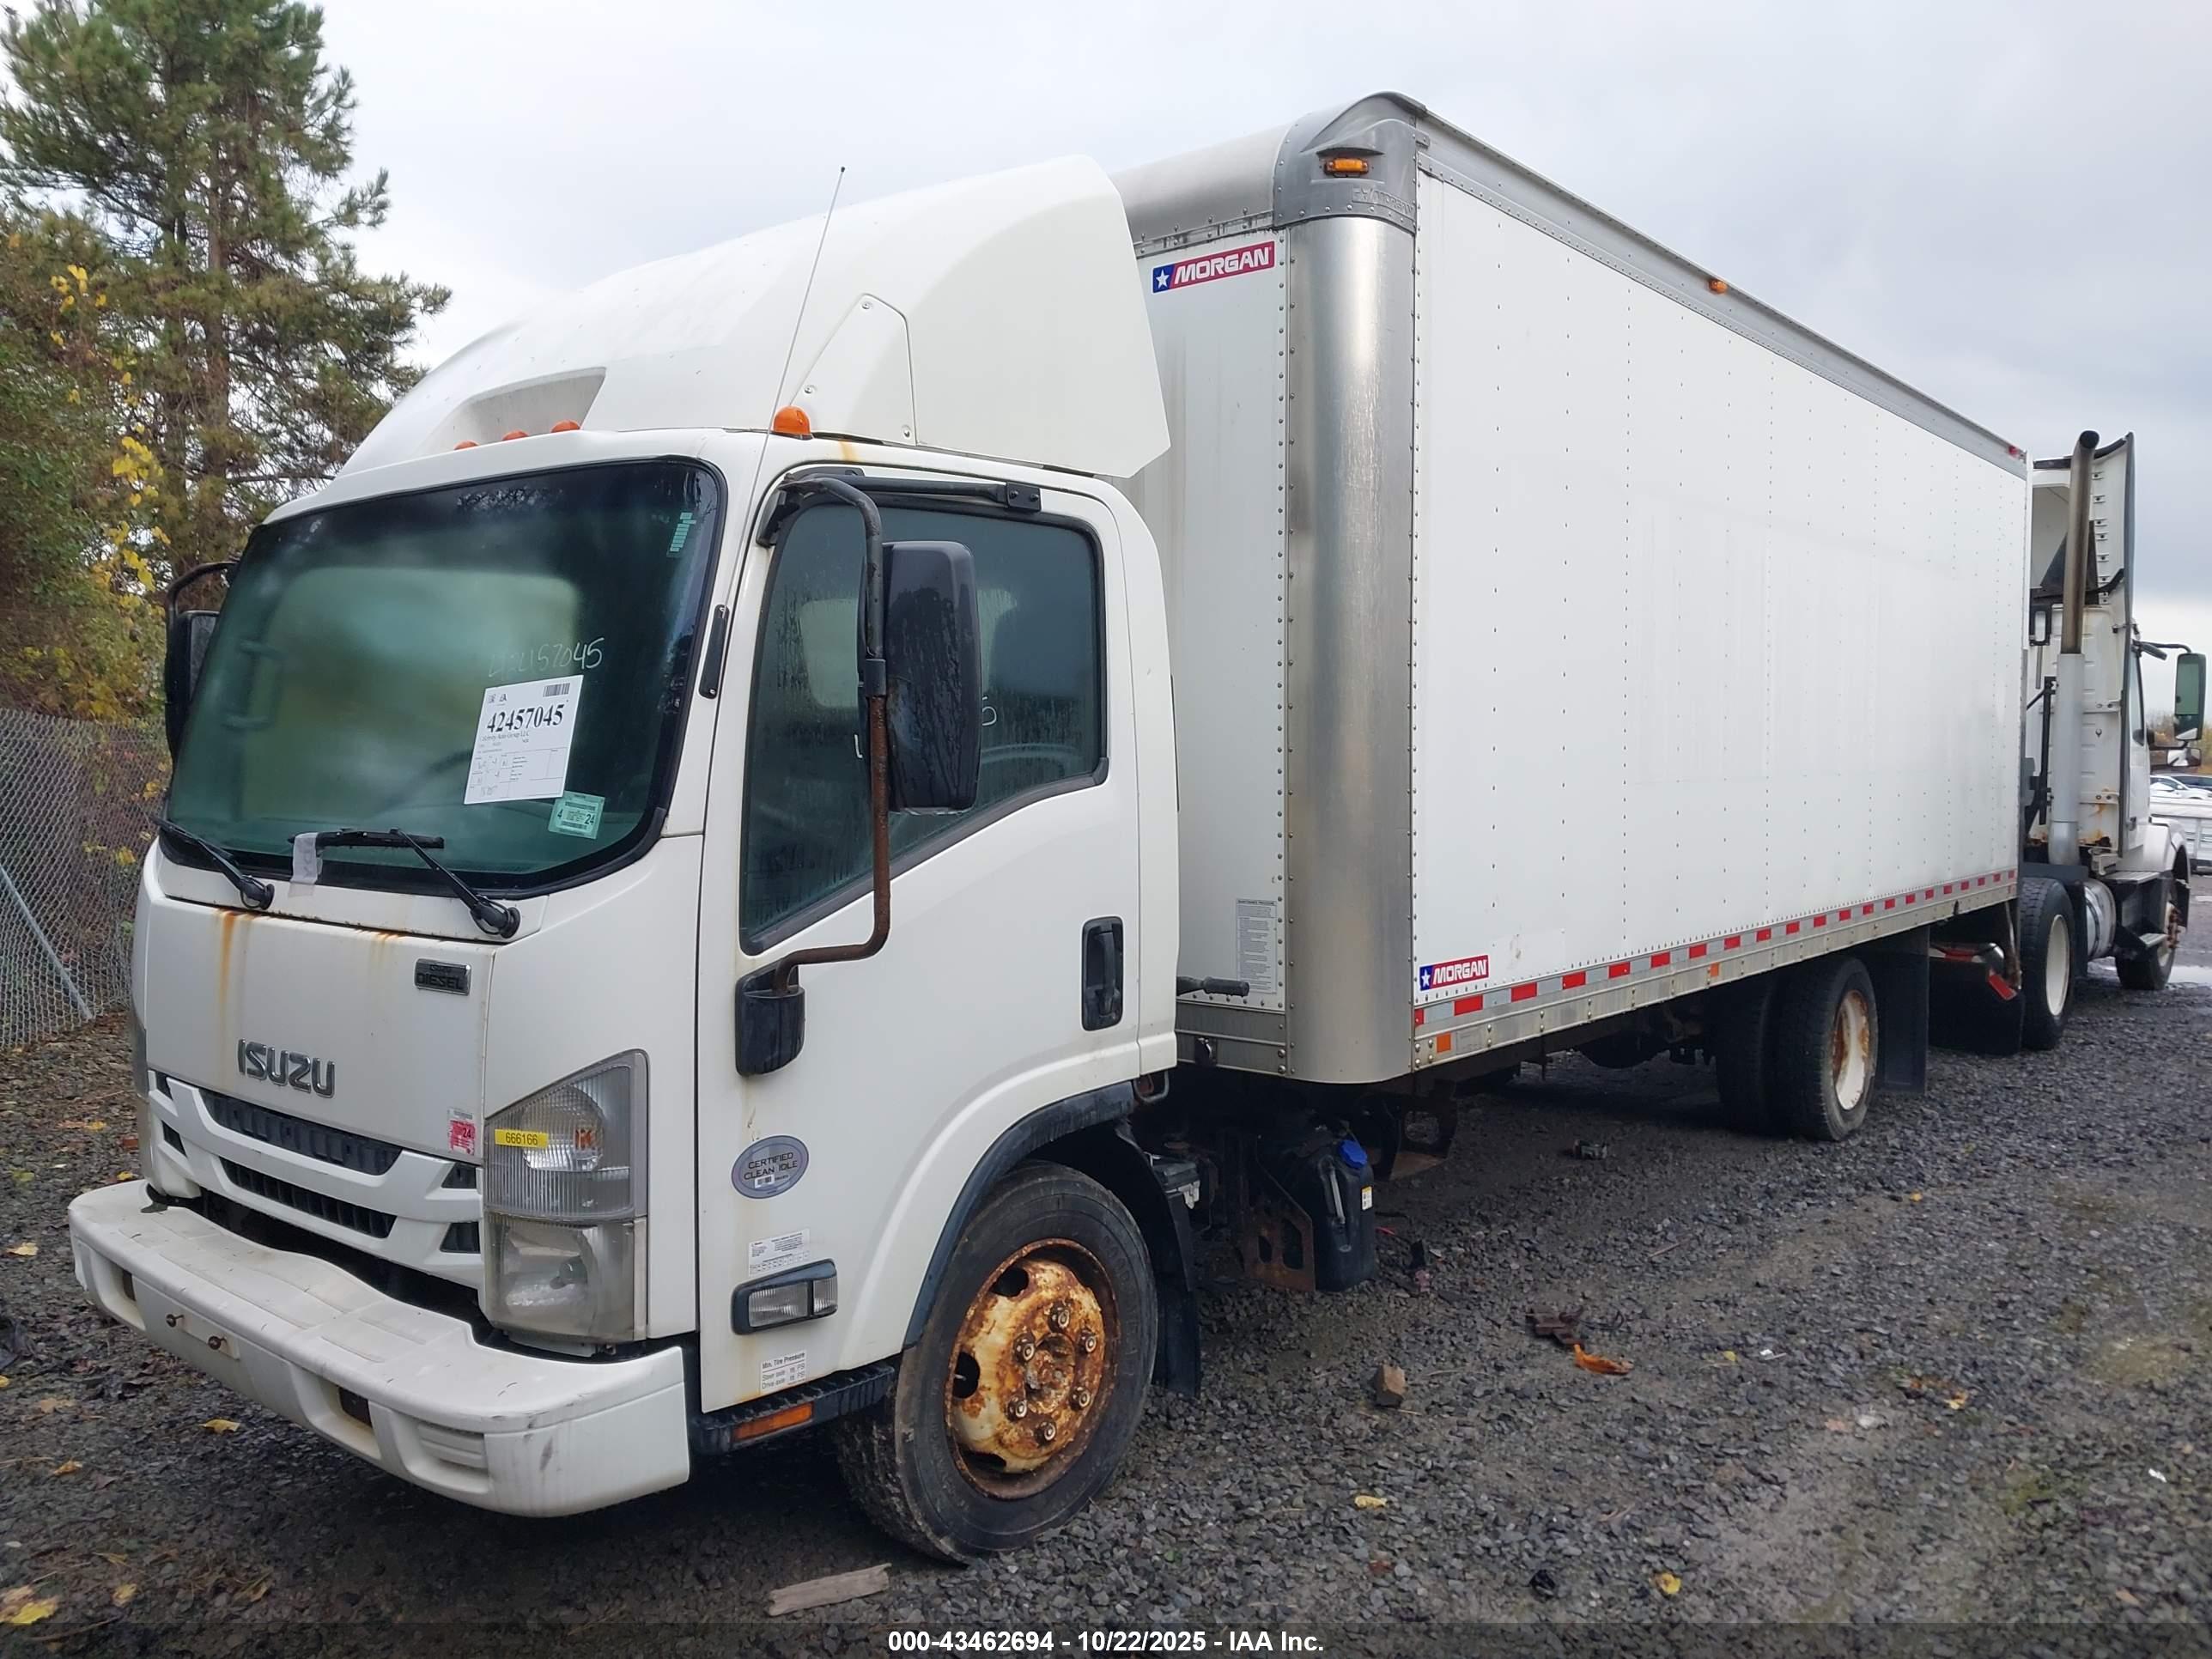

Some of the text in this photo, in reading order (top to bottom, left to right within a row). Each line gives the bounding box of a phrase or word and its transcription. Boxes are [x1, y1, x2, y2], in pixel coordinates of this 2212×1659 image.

[1174, 246, 1270, 285] MORGAN
[487, 704, 565, 732] 42457045
[584, 813, 595, 825] 24
[416, 972, 465, 990] DIESEL
[1432, 959, 1487, 985] MORGAN
[238, 1038, 335, 1098] ISUZU
[505, 1132, 538, 1146] 666166
[744, 1167, 775, 1180] CLEAN
[779, 1160, 798, 1171] IDLE
[748, 1152, 794, 1169] CERTIFIED
